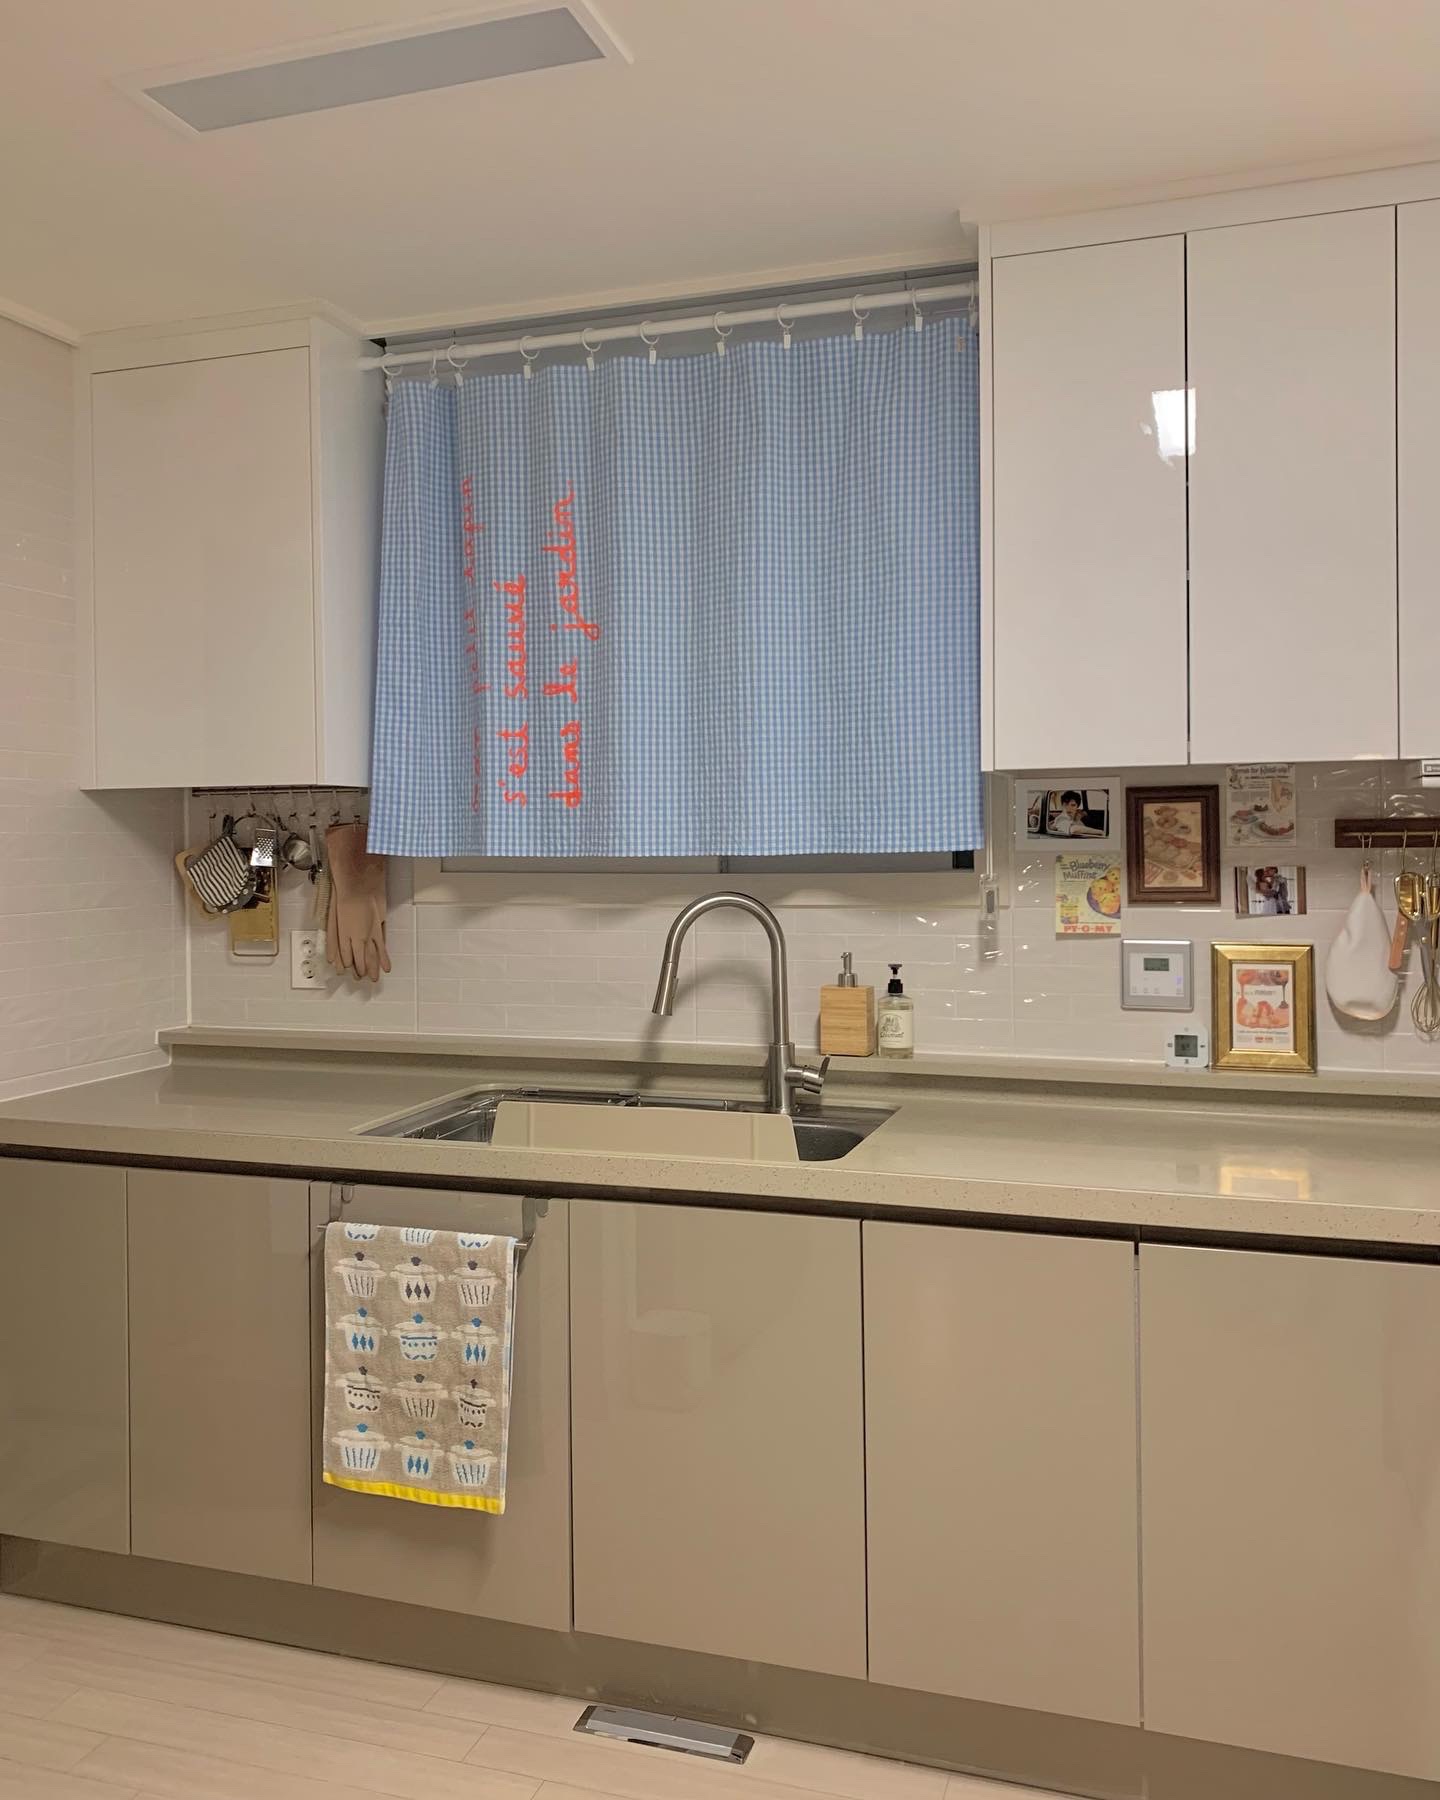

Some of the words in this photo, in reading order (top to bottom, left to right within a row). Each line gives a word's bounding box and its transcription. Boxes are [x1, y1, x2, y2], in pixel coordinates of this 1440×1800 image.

[492, 573, 529, 700] sauvé
[542, 657, 578, 704] le
[496, 721, 529, 808] s'est
[548, 720, 583, 809] dans
